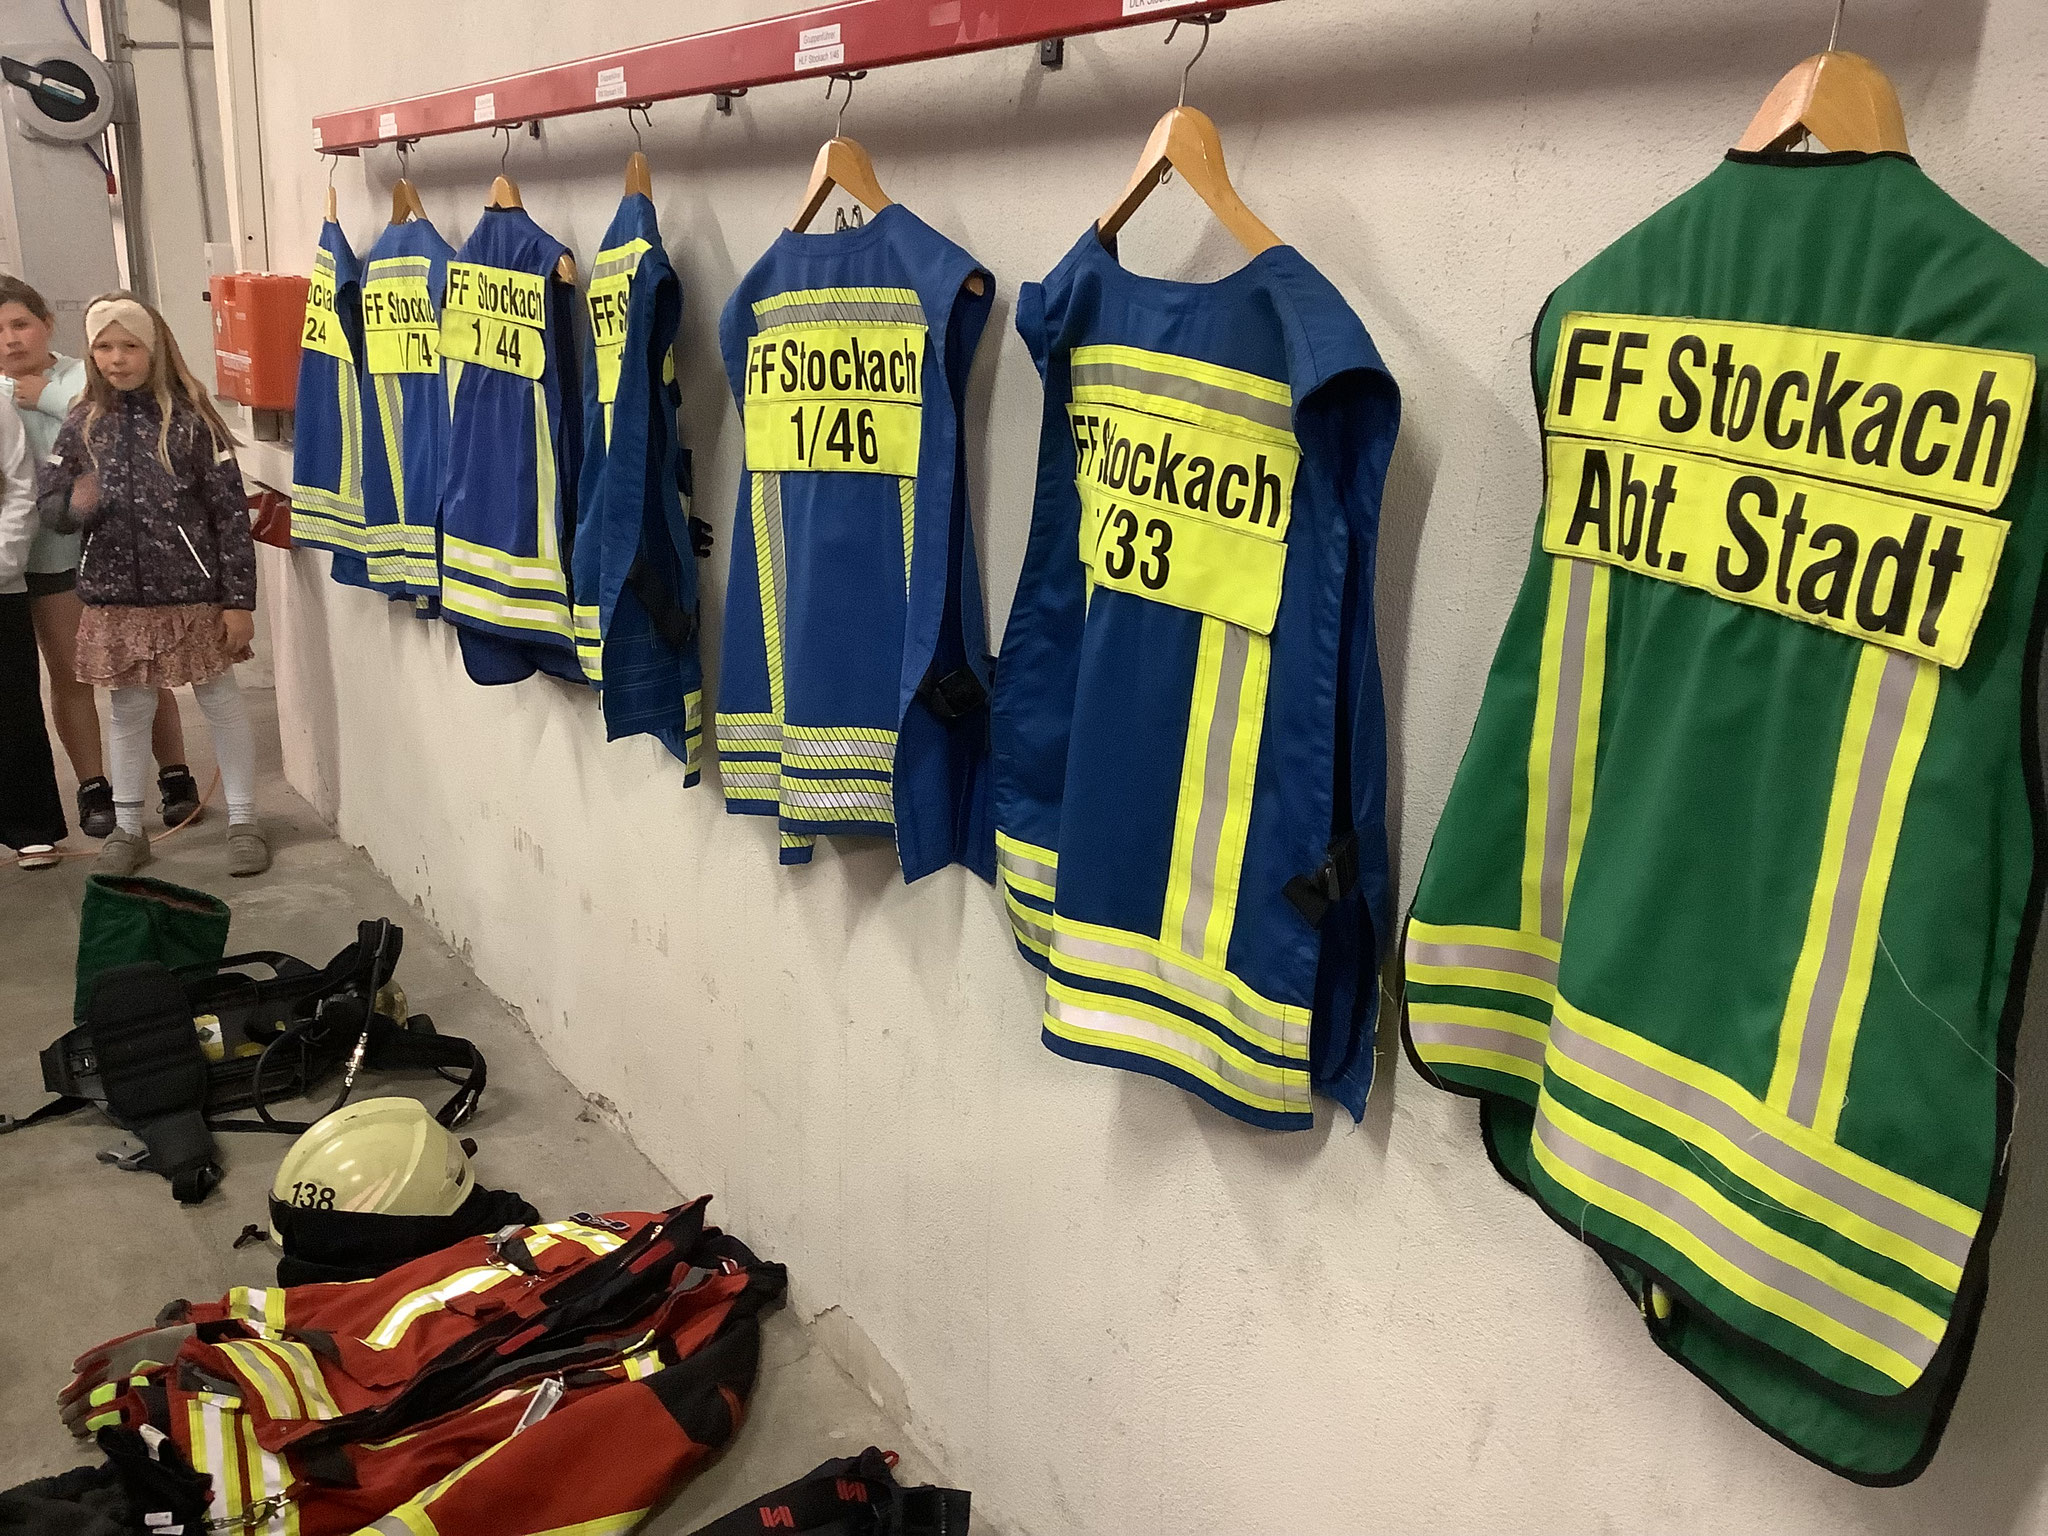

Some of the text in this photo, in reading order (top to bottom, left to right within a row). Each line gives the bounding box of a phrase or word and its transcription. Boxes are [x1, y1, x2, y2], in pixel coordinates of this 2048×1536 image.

[365, 293, 384, 325] FF
[447, 268, 543, 323] FF Stockach
[589, 294, 615, 338] FF
[748, 336, 917, 395] FF Stockach
[790, 405, 879, 468] 1/46
[1557, 328, 2012, 487] FF Stockach
[1072, 414, 1100, 476] FF
[1564, 448, 1965, 647] Abt. Stadt
[292, 1181, 336, 1212] 138
